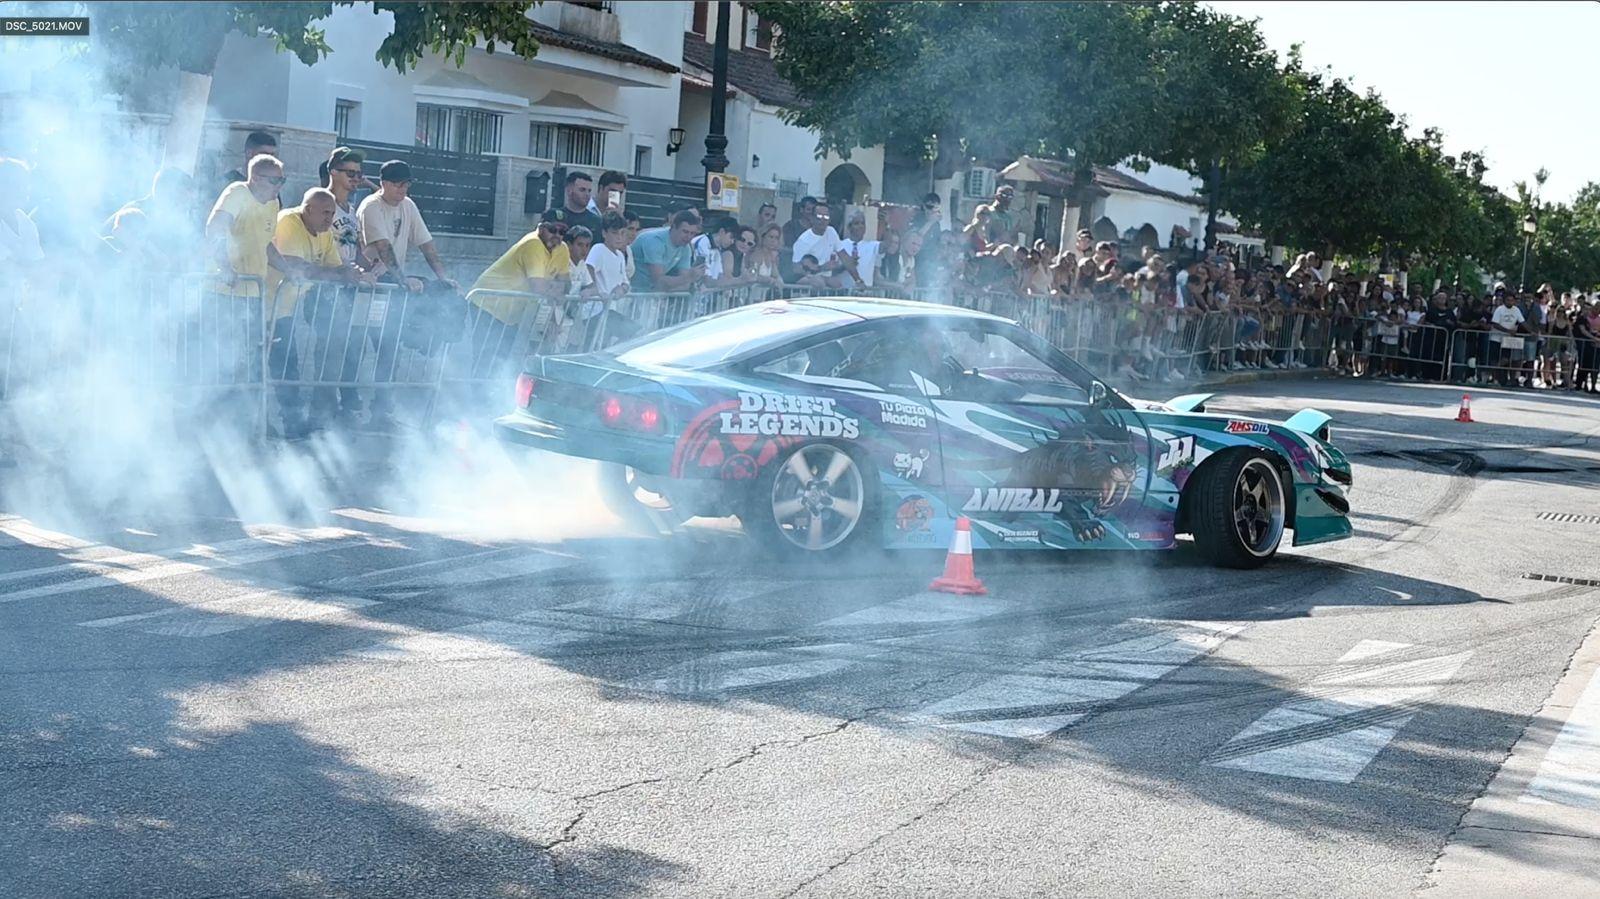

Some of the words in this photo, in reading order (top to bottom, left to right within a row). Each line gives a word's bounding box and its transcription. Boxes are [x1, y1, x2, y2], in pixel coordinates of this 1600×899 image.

[738, 392, 837, 414] DRIFT
[720, 413, 860, 440] LEGENDS
[1225, 419, 1270, 434] AMSOIL
[961, 487, 1063, 513] ANIBAL
